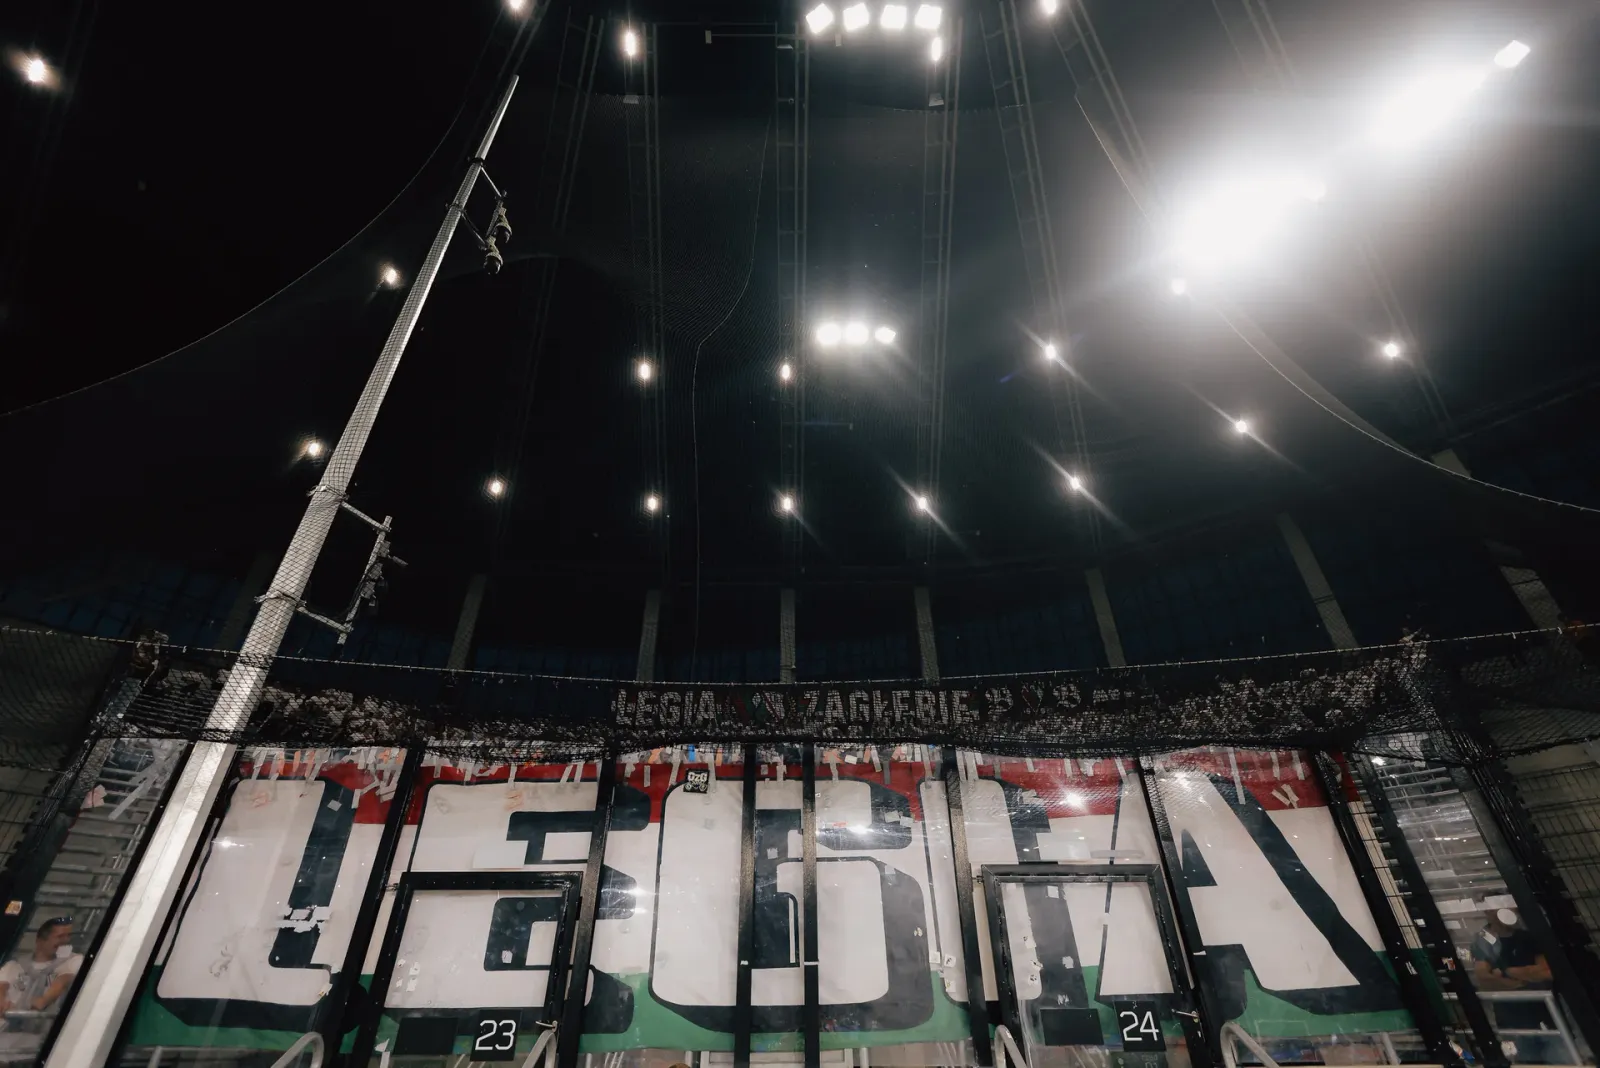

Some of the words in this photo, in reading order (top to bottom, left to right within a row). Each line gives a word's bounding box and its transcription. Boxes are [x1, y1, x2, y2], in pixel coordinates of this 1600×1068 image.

[613, 688, 719, 727] LEGIA
[150, 773, 1395, 1033] LEGIA
[475, 1019, 517, 1051] 23
[1119, 1010, 1160, 1042] 24
